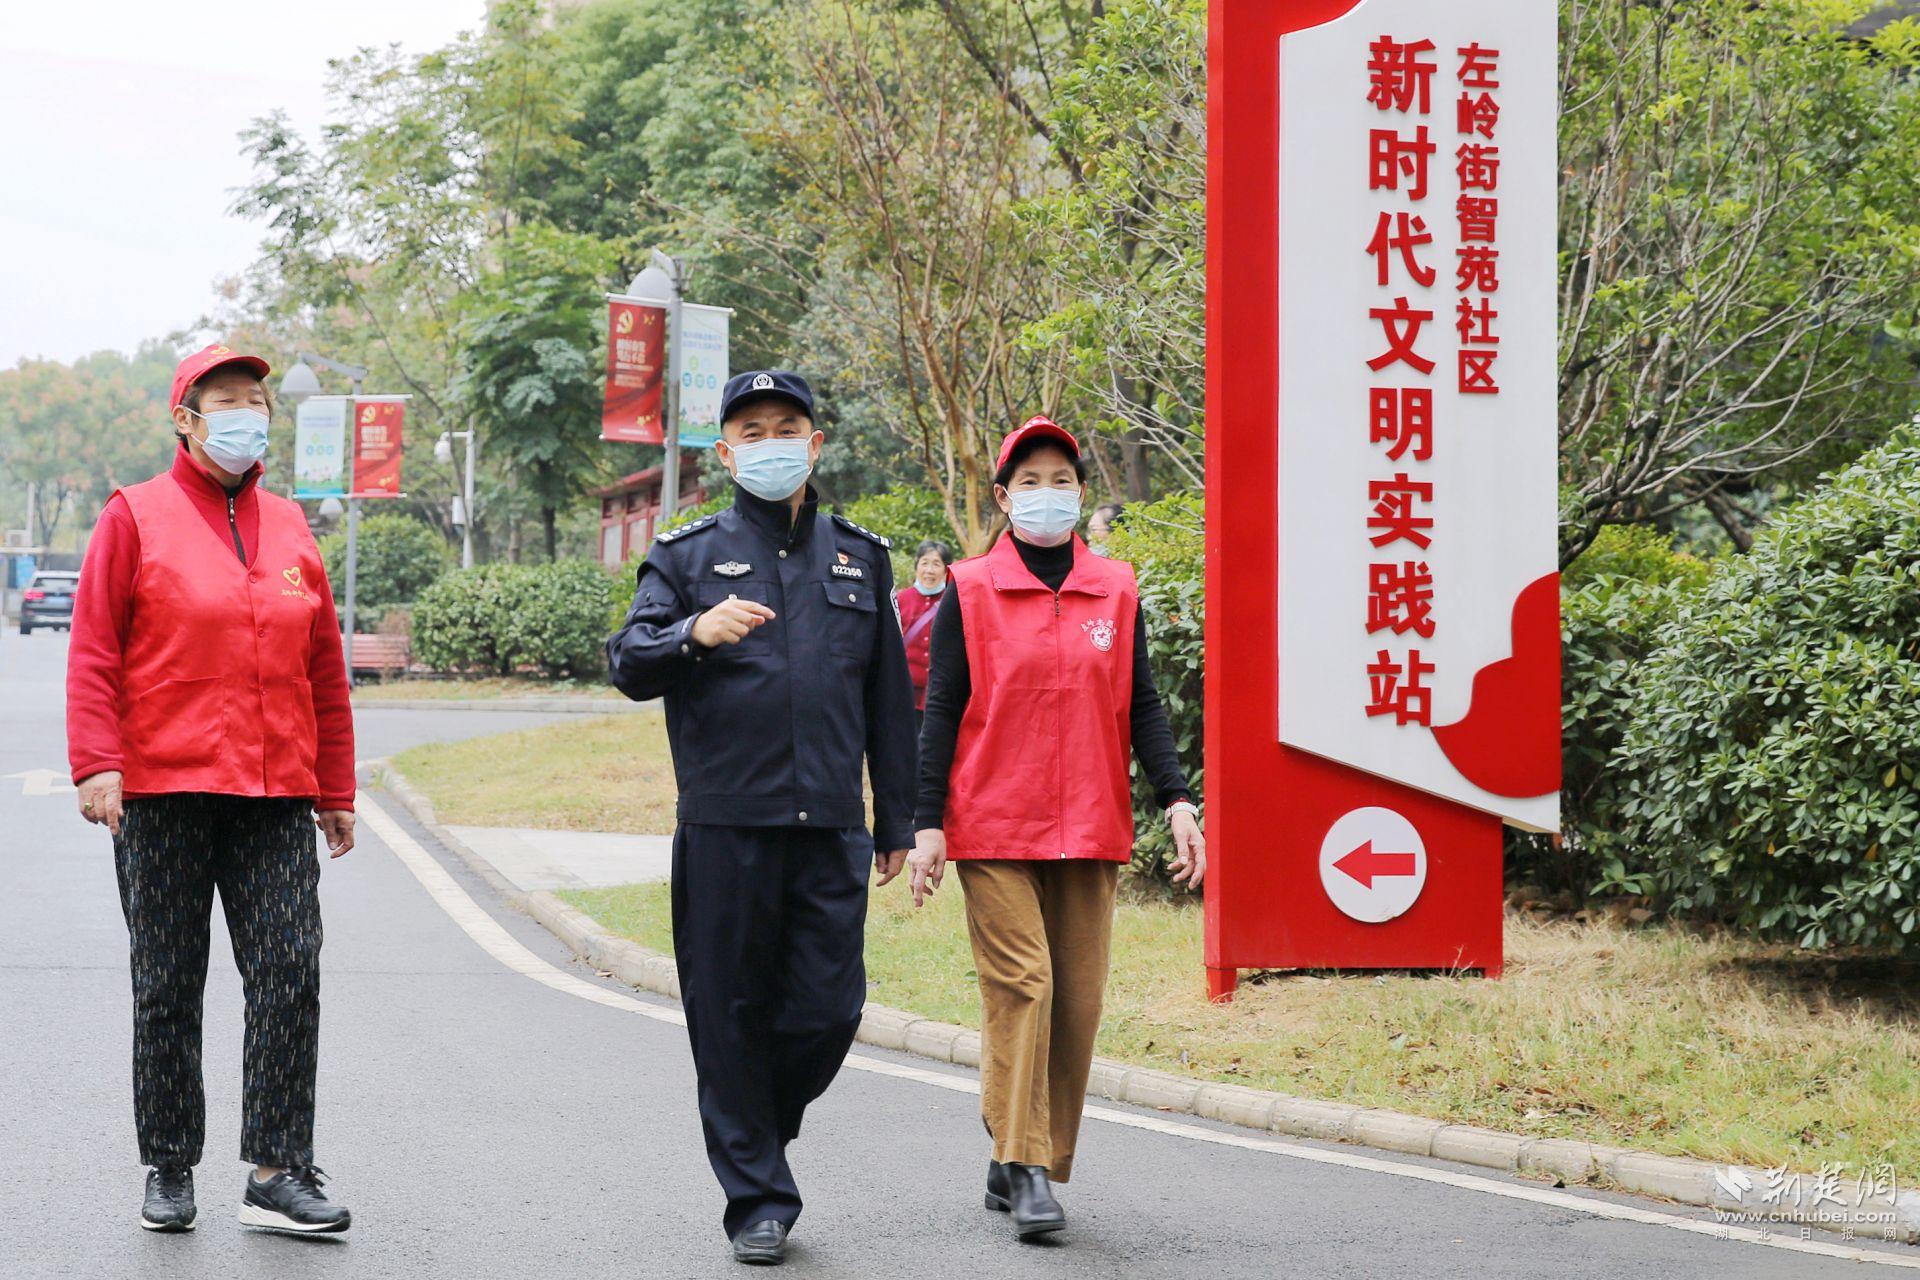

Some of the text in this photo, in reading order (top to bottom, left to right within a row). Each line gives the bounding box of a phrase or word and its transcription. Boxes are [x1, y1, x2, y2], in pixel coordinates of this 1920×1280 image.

[1365, 35, 1437, 726] 新时代文明实践站
[1455, 42, 1499, 394] 左岭街智苑社区
